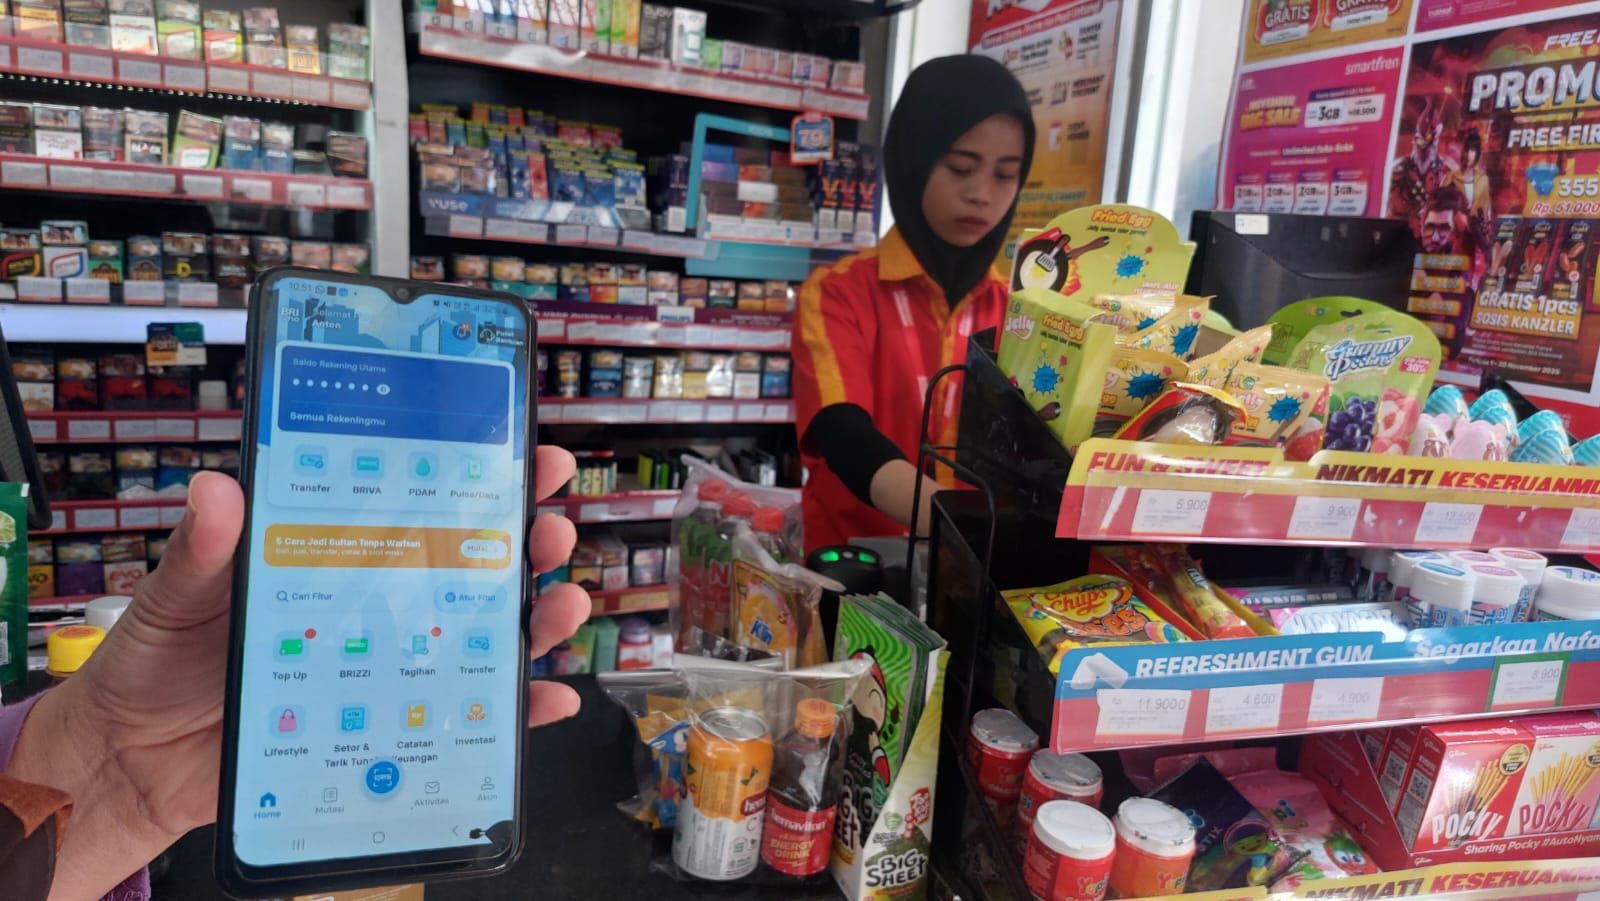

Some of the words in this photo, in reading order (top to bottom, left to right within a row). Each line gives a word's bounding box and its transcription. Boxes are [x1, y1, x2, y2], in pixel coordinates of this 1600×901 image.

[1265, 4, 1310, 28] GRATIS
[1543, 29, 1597, 50] FREE
[1345, 56, 1399, 75] smartfren
[1508, 126, 1563, 148] FREE
[1559, 178, 1599, 197] 355
[1091, 209, 1128, 224] Fried
[1128, 213, 1153, 228] Egg
[1479, 291, 1532, 310] GRATIS
[1537, 296, 1578, 316] 1pcs
[312, 320, 341, 329] Anton
[1005, 315, 1035, 340] Jelly
[1042, 313, 1065, 332] Fried
[1476, 312, 1507, 326] SOSIS
[1511, 315, 1575, 334] KANZLER
[319, 360, 357, 372] Rekening
[290, 411, 324, 422] Semua
[326, 413, 385, 427] Rekeningmu
[1090, 452, 1145, 473] FUN
[1316, 464, 1433, 486] NIKMATI
[290, 483, 331, 493] Transfer
[353, 486, 382, 495] BRIVA
[409, 488, 436, 497] PDAM
[285, 538, 305, 546] Cara
[387, 539, 420, 548] Warisan
[291, 592, 310, 600] Cari
[313, 592, 333, 600] Fitur
[1050, 588, 1107, 616] Chups
[1414, 636, 1537, 664] Segarkan
[1135, 648, 1312, 678] REFRESHMENT
[1315, 645, 1373, 664] GUM
[272, 671, 291, 682] Top
[294, 671, 307, 682] Up
[340, 669, 370, 679] BRIZZI
[400, 667, 435, 677] Tagihan
[460, 666, 496, 675] Transfer
[334, 744, 359, 753] Setor
[362, 743, 369, 752] &
[397, 740, 434, 750] Catatan
[455, 736, 496, 746] Investasi
[264, 746, 308, 757] Lifestyle
[325, 758, 348, 768] Tarik
[254, 810, 281, 819] Home
[315, 805, 344, 814] Mutasi
[1519, 801, 1591, 835] POCKY
[1431, 809, 1504, 845] POCKY
[770, 838, 815, 850] ENERGY
[1464, 842, 1506, 856] Sharing
[1508, 840, 1540, 852] Pocky
[775, 849, 810, 860] DRINK
[880, 849, 918, 874] BIG
